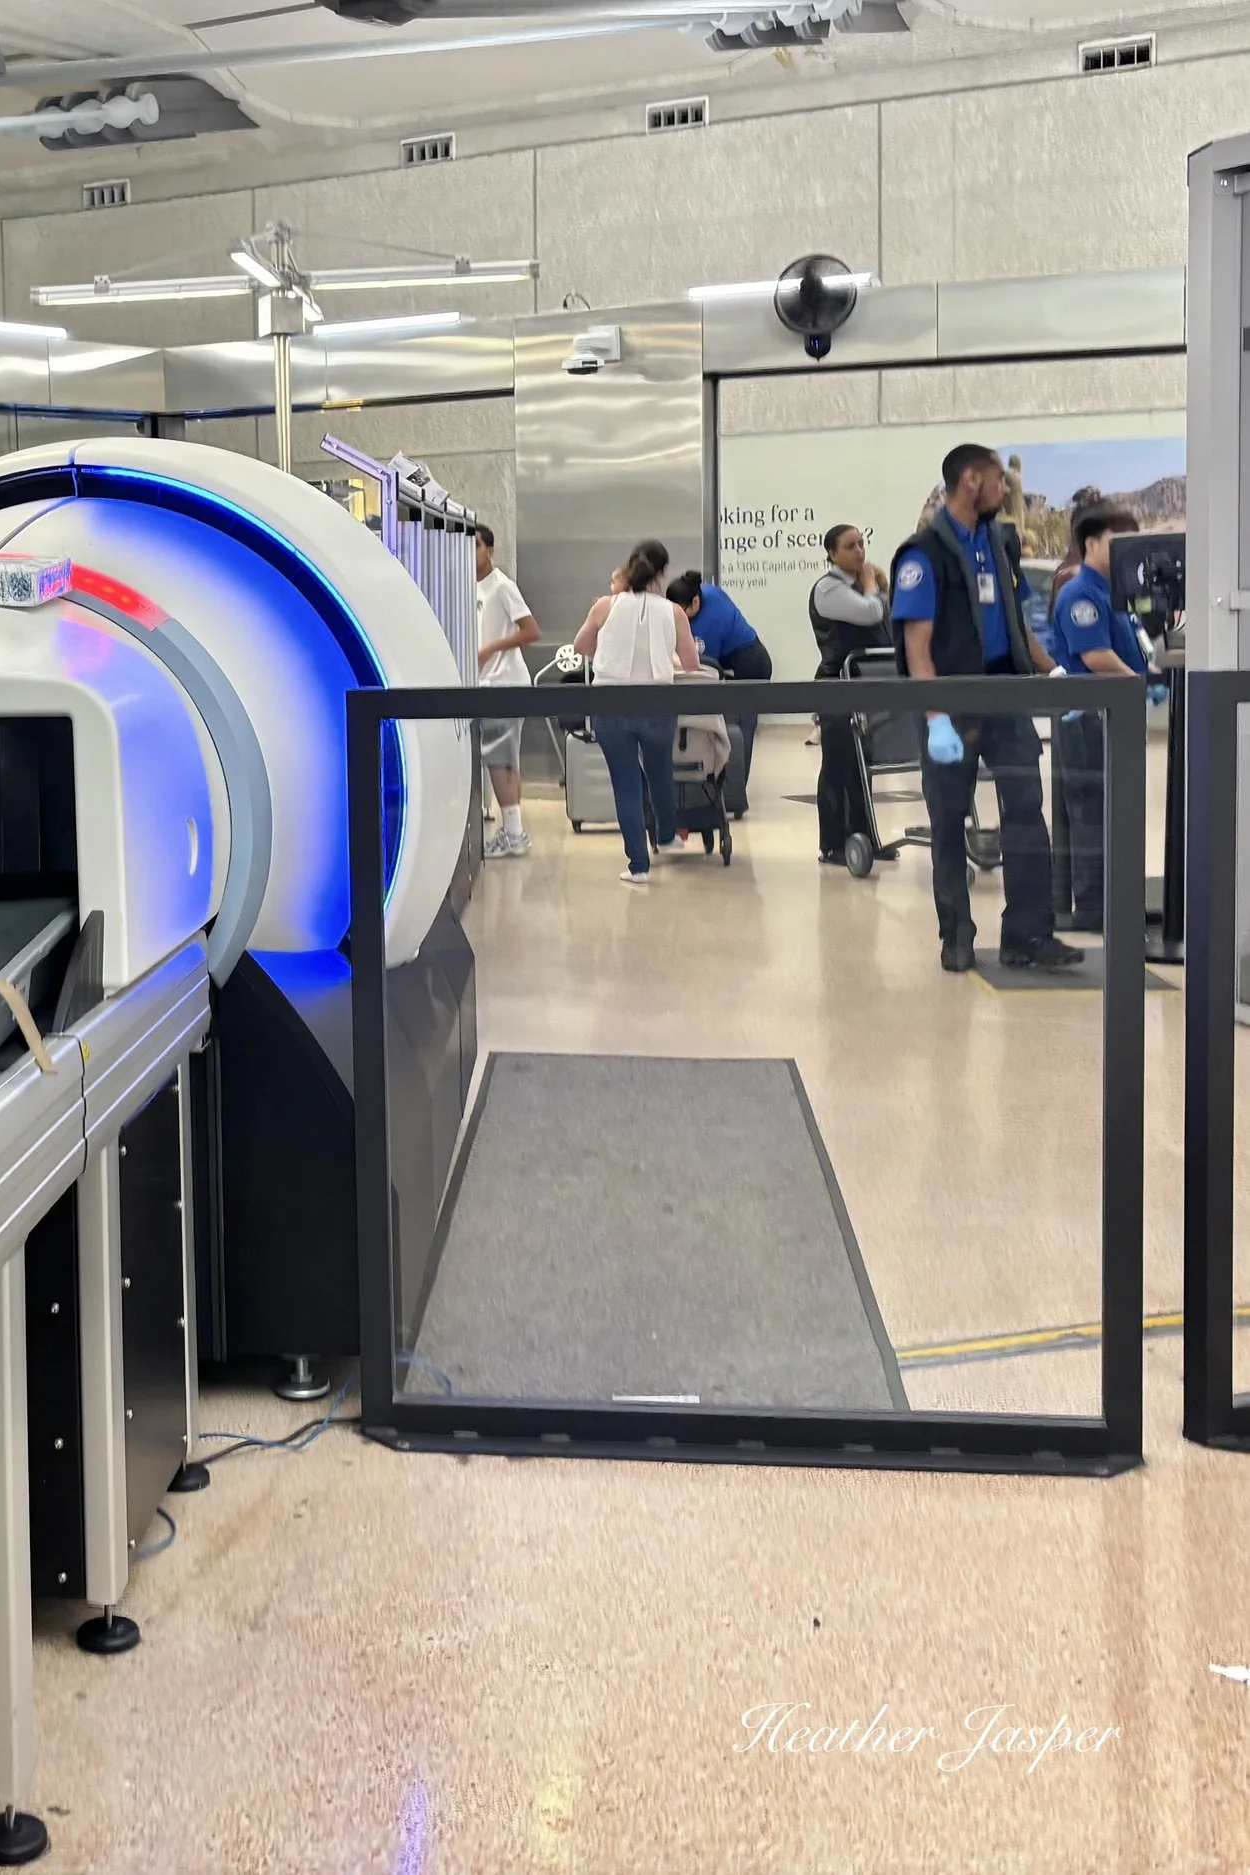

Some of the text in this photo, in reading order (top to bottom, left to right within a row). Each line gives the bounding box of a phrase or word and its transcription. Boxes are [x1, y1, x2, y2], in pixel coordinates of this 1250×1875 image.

[771, 504, 799, 522] for
[804, 507, 815, 521] a
[762, 530, 783, 548] of
[762, 559, 796, 574] Capital
